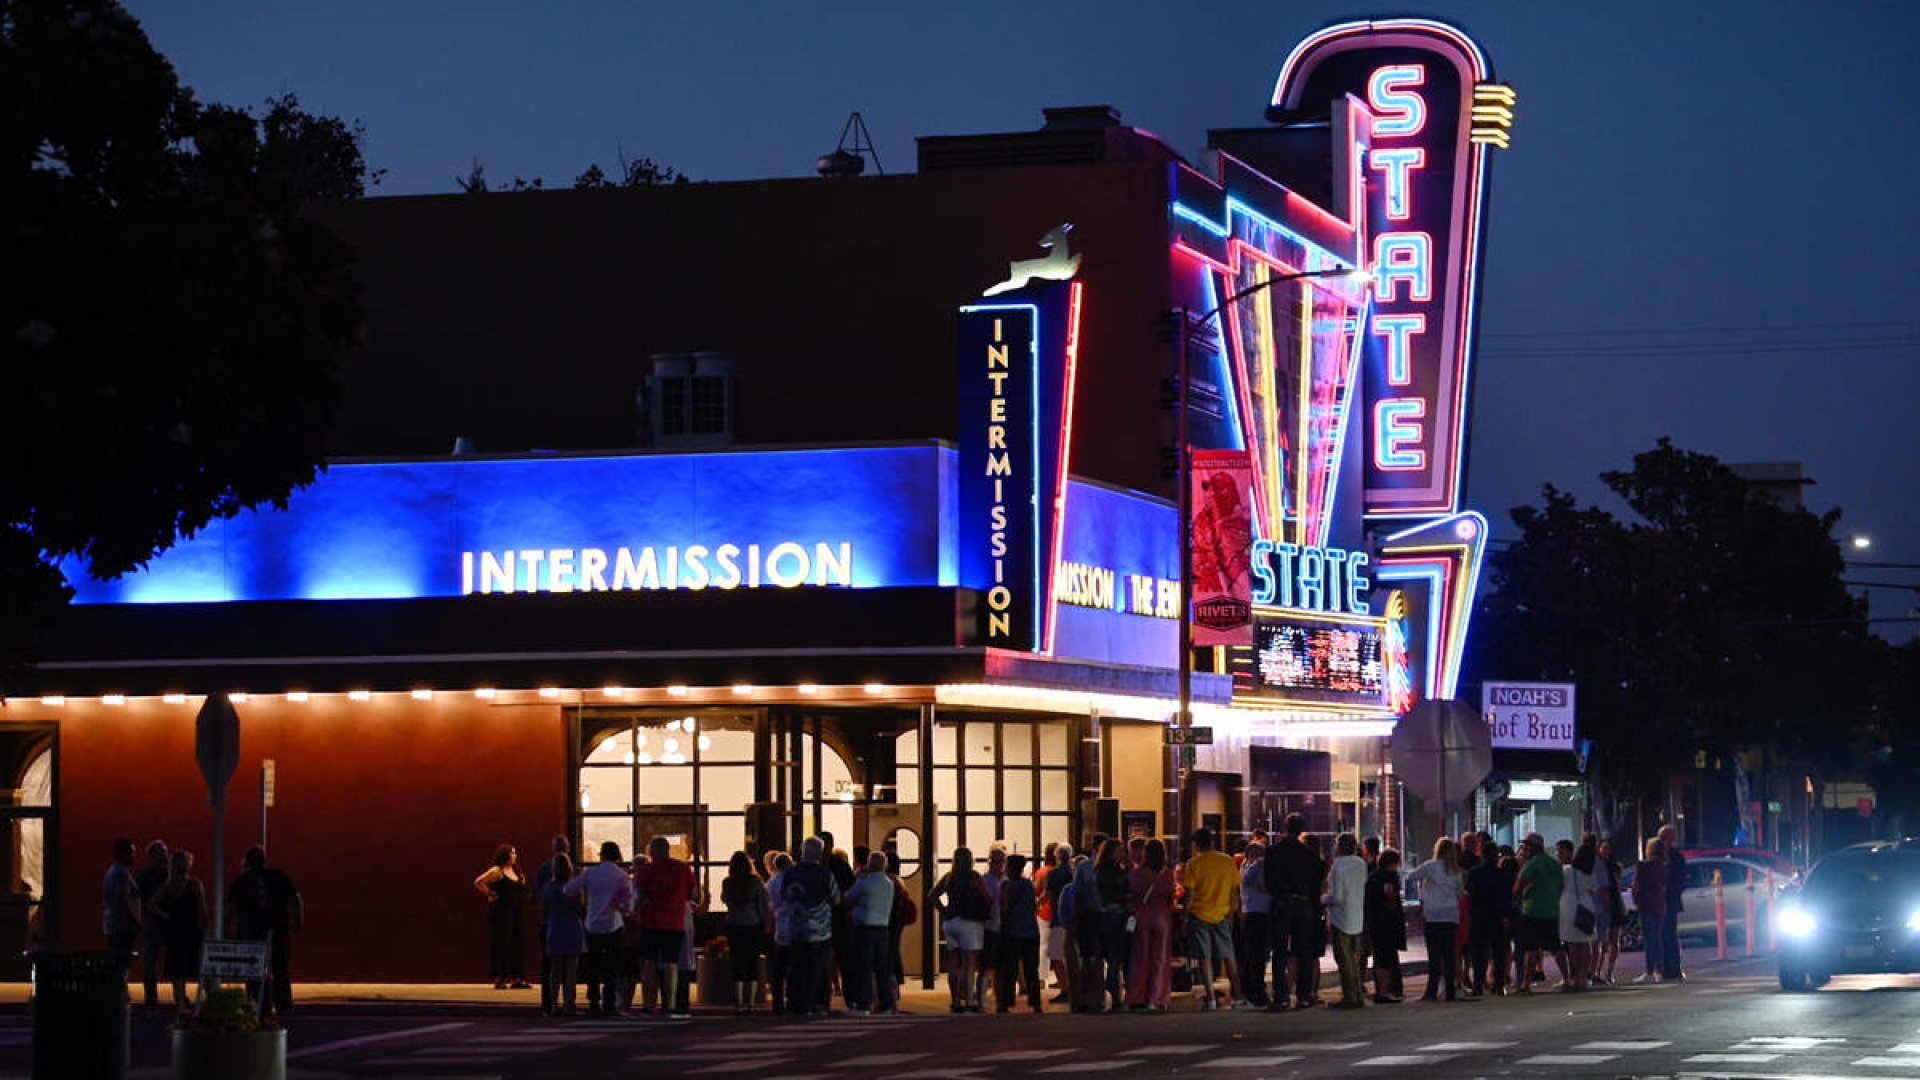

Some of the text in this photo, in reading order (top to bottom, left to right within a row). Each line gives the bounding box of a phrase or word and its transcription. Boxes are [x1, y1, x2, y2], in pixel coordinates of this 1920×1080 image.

[1367, 64, 1432, 471] STATE
[986, 319, 1011, 637] INTERMISSION
[462, 542, 851, 594] INTERMISSION
[1251, 539, 1370, 615] STATE
[1131, 574, 1152, 615] THE
[1496, 690, 1561, 705] NOAH'S
[1527, 712, 1572, 740] Brau
